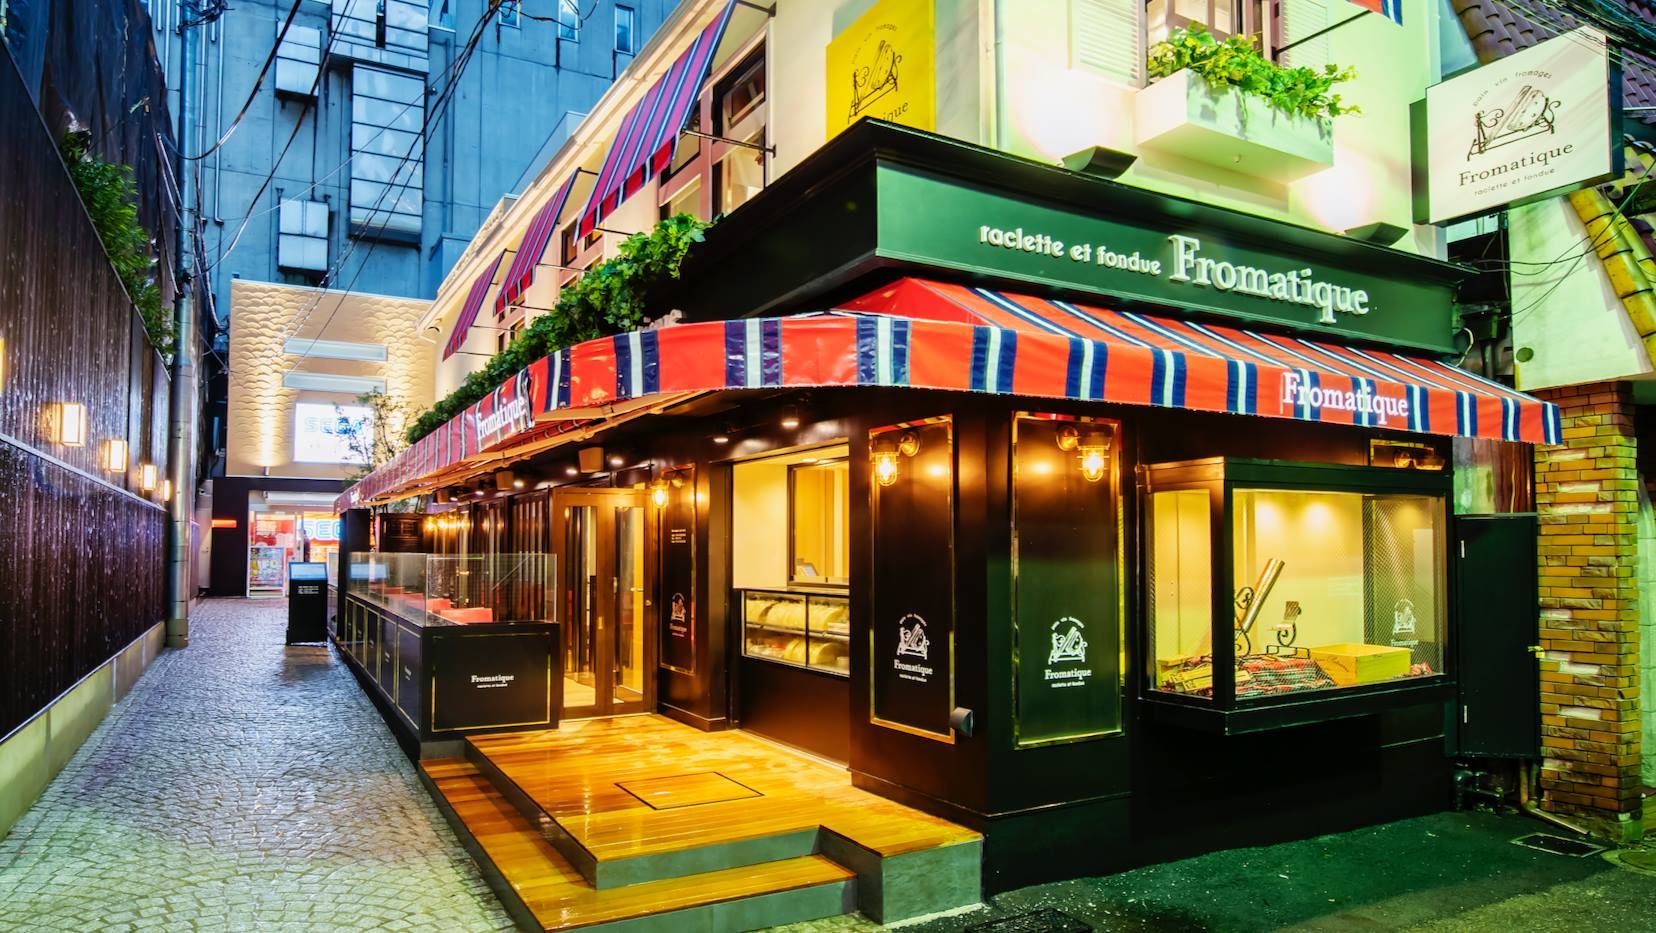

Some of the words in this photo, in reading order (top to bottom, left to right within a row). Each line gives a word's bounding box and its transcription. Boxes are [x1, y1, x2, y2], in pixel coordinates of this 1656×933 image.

[1515, 70, 1552, 80] fromages
[1459, 144, 1574, 187] Fromatique
[1524, 168, 1555, 181] fondue
[979, 225, 1065, 258] raclette
[1069, 243, 1092, 263] et
[1096, 245, 1162, 276] fondue
[1168, 234, 1370, 324] Fromatique
[1282, 372, 1409, 425] Fromatique
[477, 396, 526, 440] Fromatique
[894, 659, 933, 677] Fromatique
[1044, 668, 1092, 680] Fromatique
[471, 674, 515, 683] Fromatique
